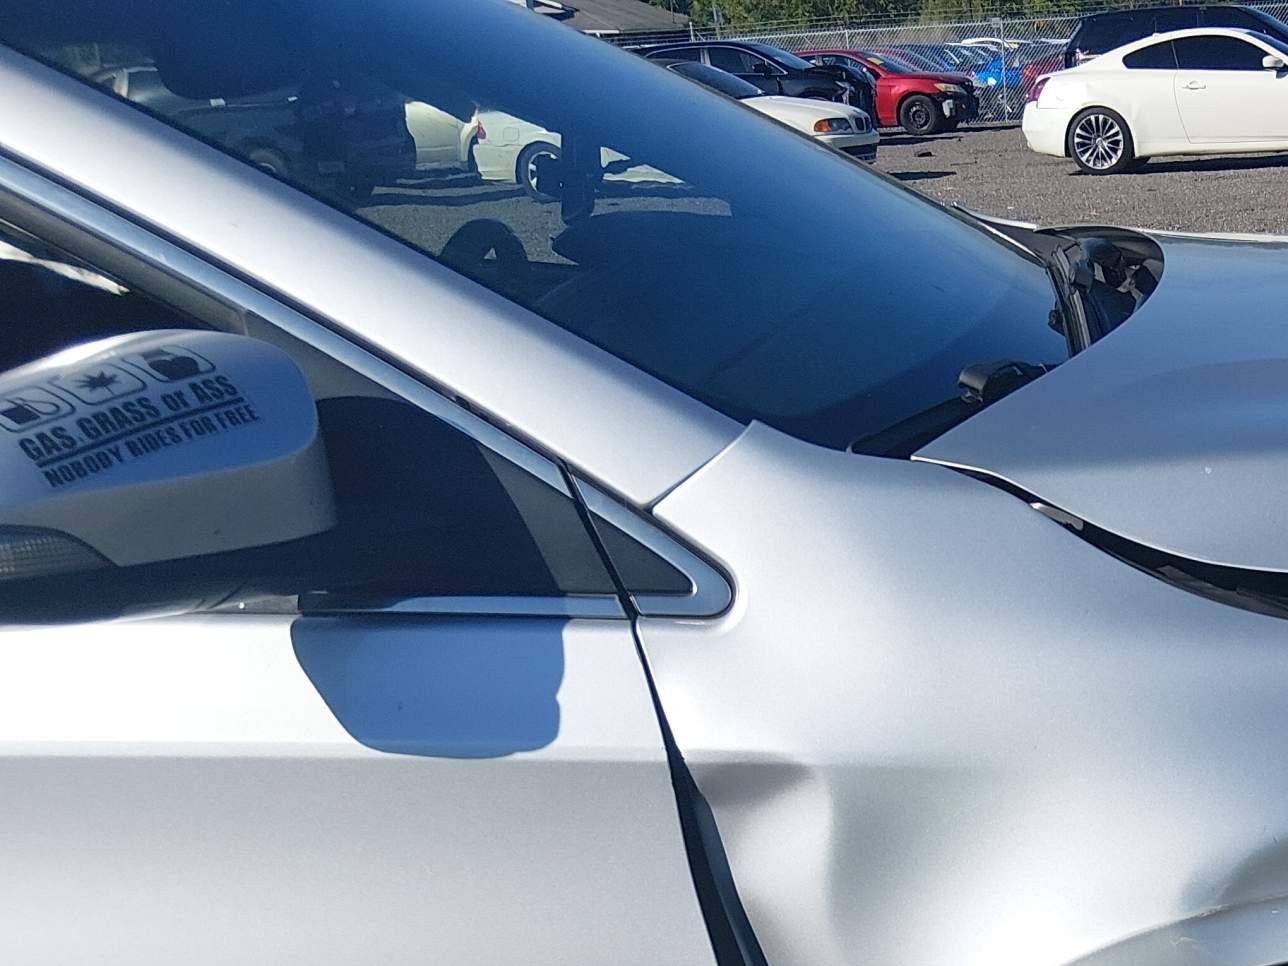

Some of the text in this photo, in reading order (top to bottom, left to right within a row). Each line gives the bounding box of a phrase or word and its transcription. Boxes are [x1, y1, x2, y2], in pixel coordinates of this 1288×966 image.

[76, 397, 160, 440] GRASS
[188, 376, 238, 402] ASS
[42, 405, 260, 488] NOBODY RIDES FOR FREE
